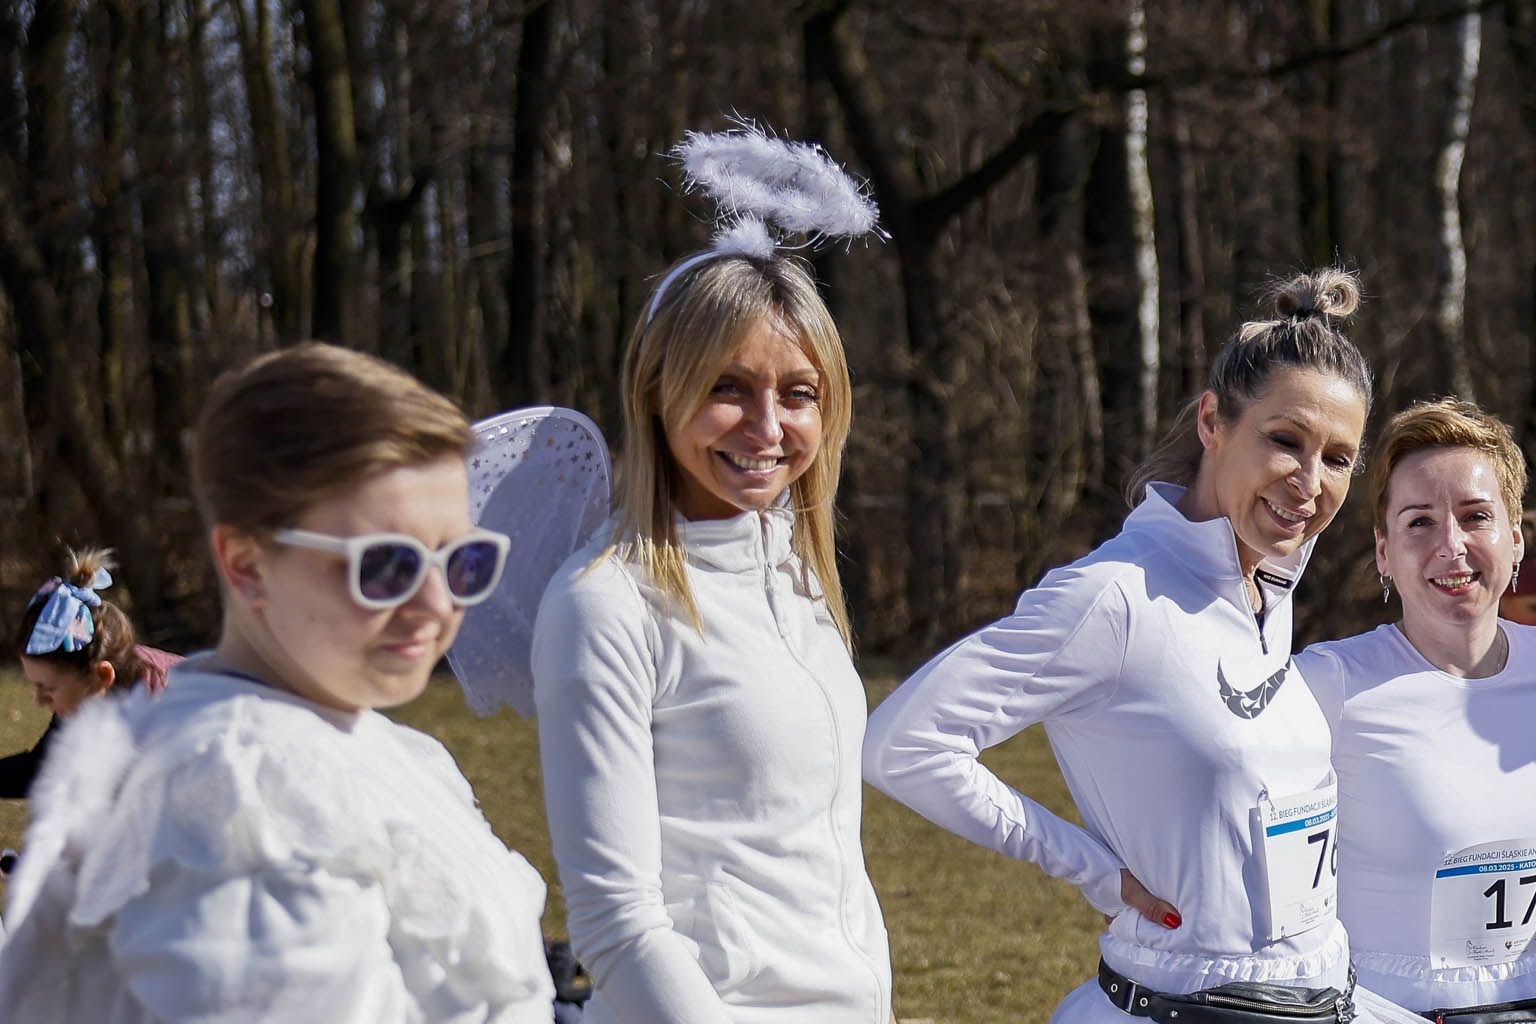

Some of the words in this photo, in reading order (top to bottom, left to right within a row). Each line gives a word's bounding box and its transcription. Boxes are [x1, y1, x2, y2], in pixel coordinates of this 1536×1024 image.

[1453, 854, 1468, 865] BIEG
[1468, 851, 1501, 862] FUNDACJI
[1501, 847, 1528, 859] ŚLĄSKIE
[1479, 863, 1515, 872] 08.03.2025
